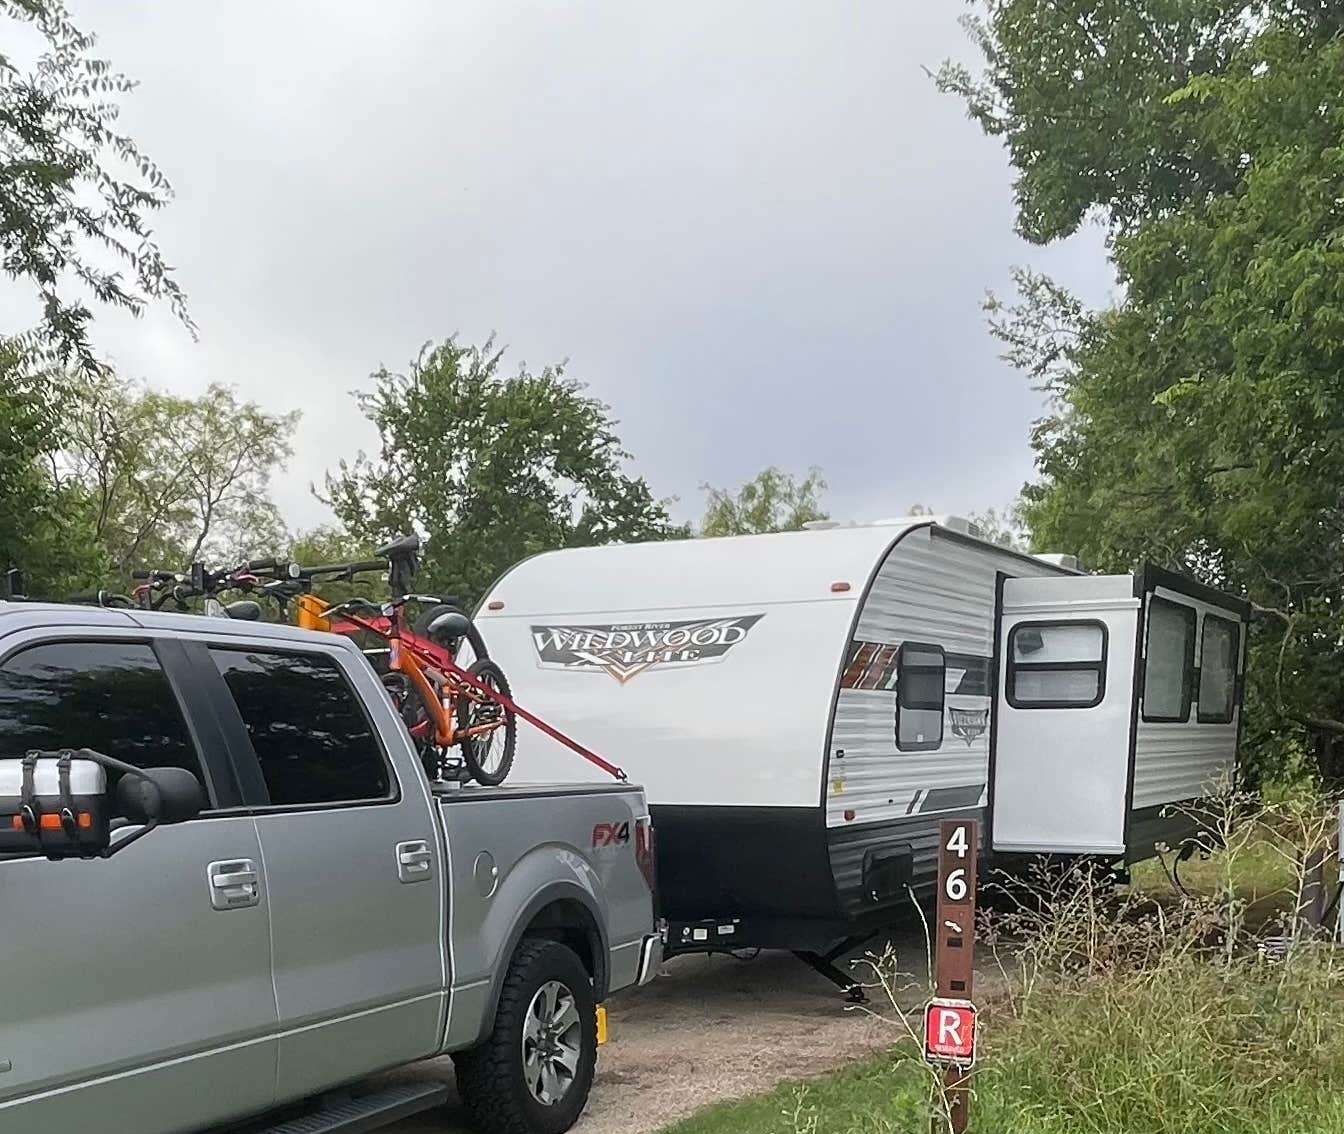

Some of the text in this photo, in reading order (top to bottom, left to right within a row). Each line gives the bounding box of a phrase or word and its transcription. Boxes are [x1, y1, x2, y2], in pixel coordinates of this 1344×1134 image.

[533, 626, 748, 651] WILDWOOD
[592, 821, 630, 849] FX4
[938, 1009, 963, 1046] R
